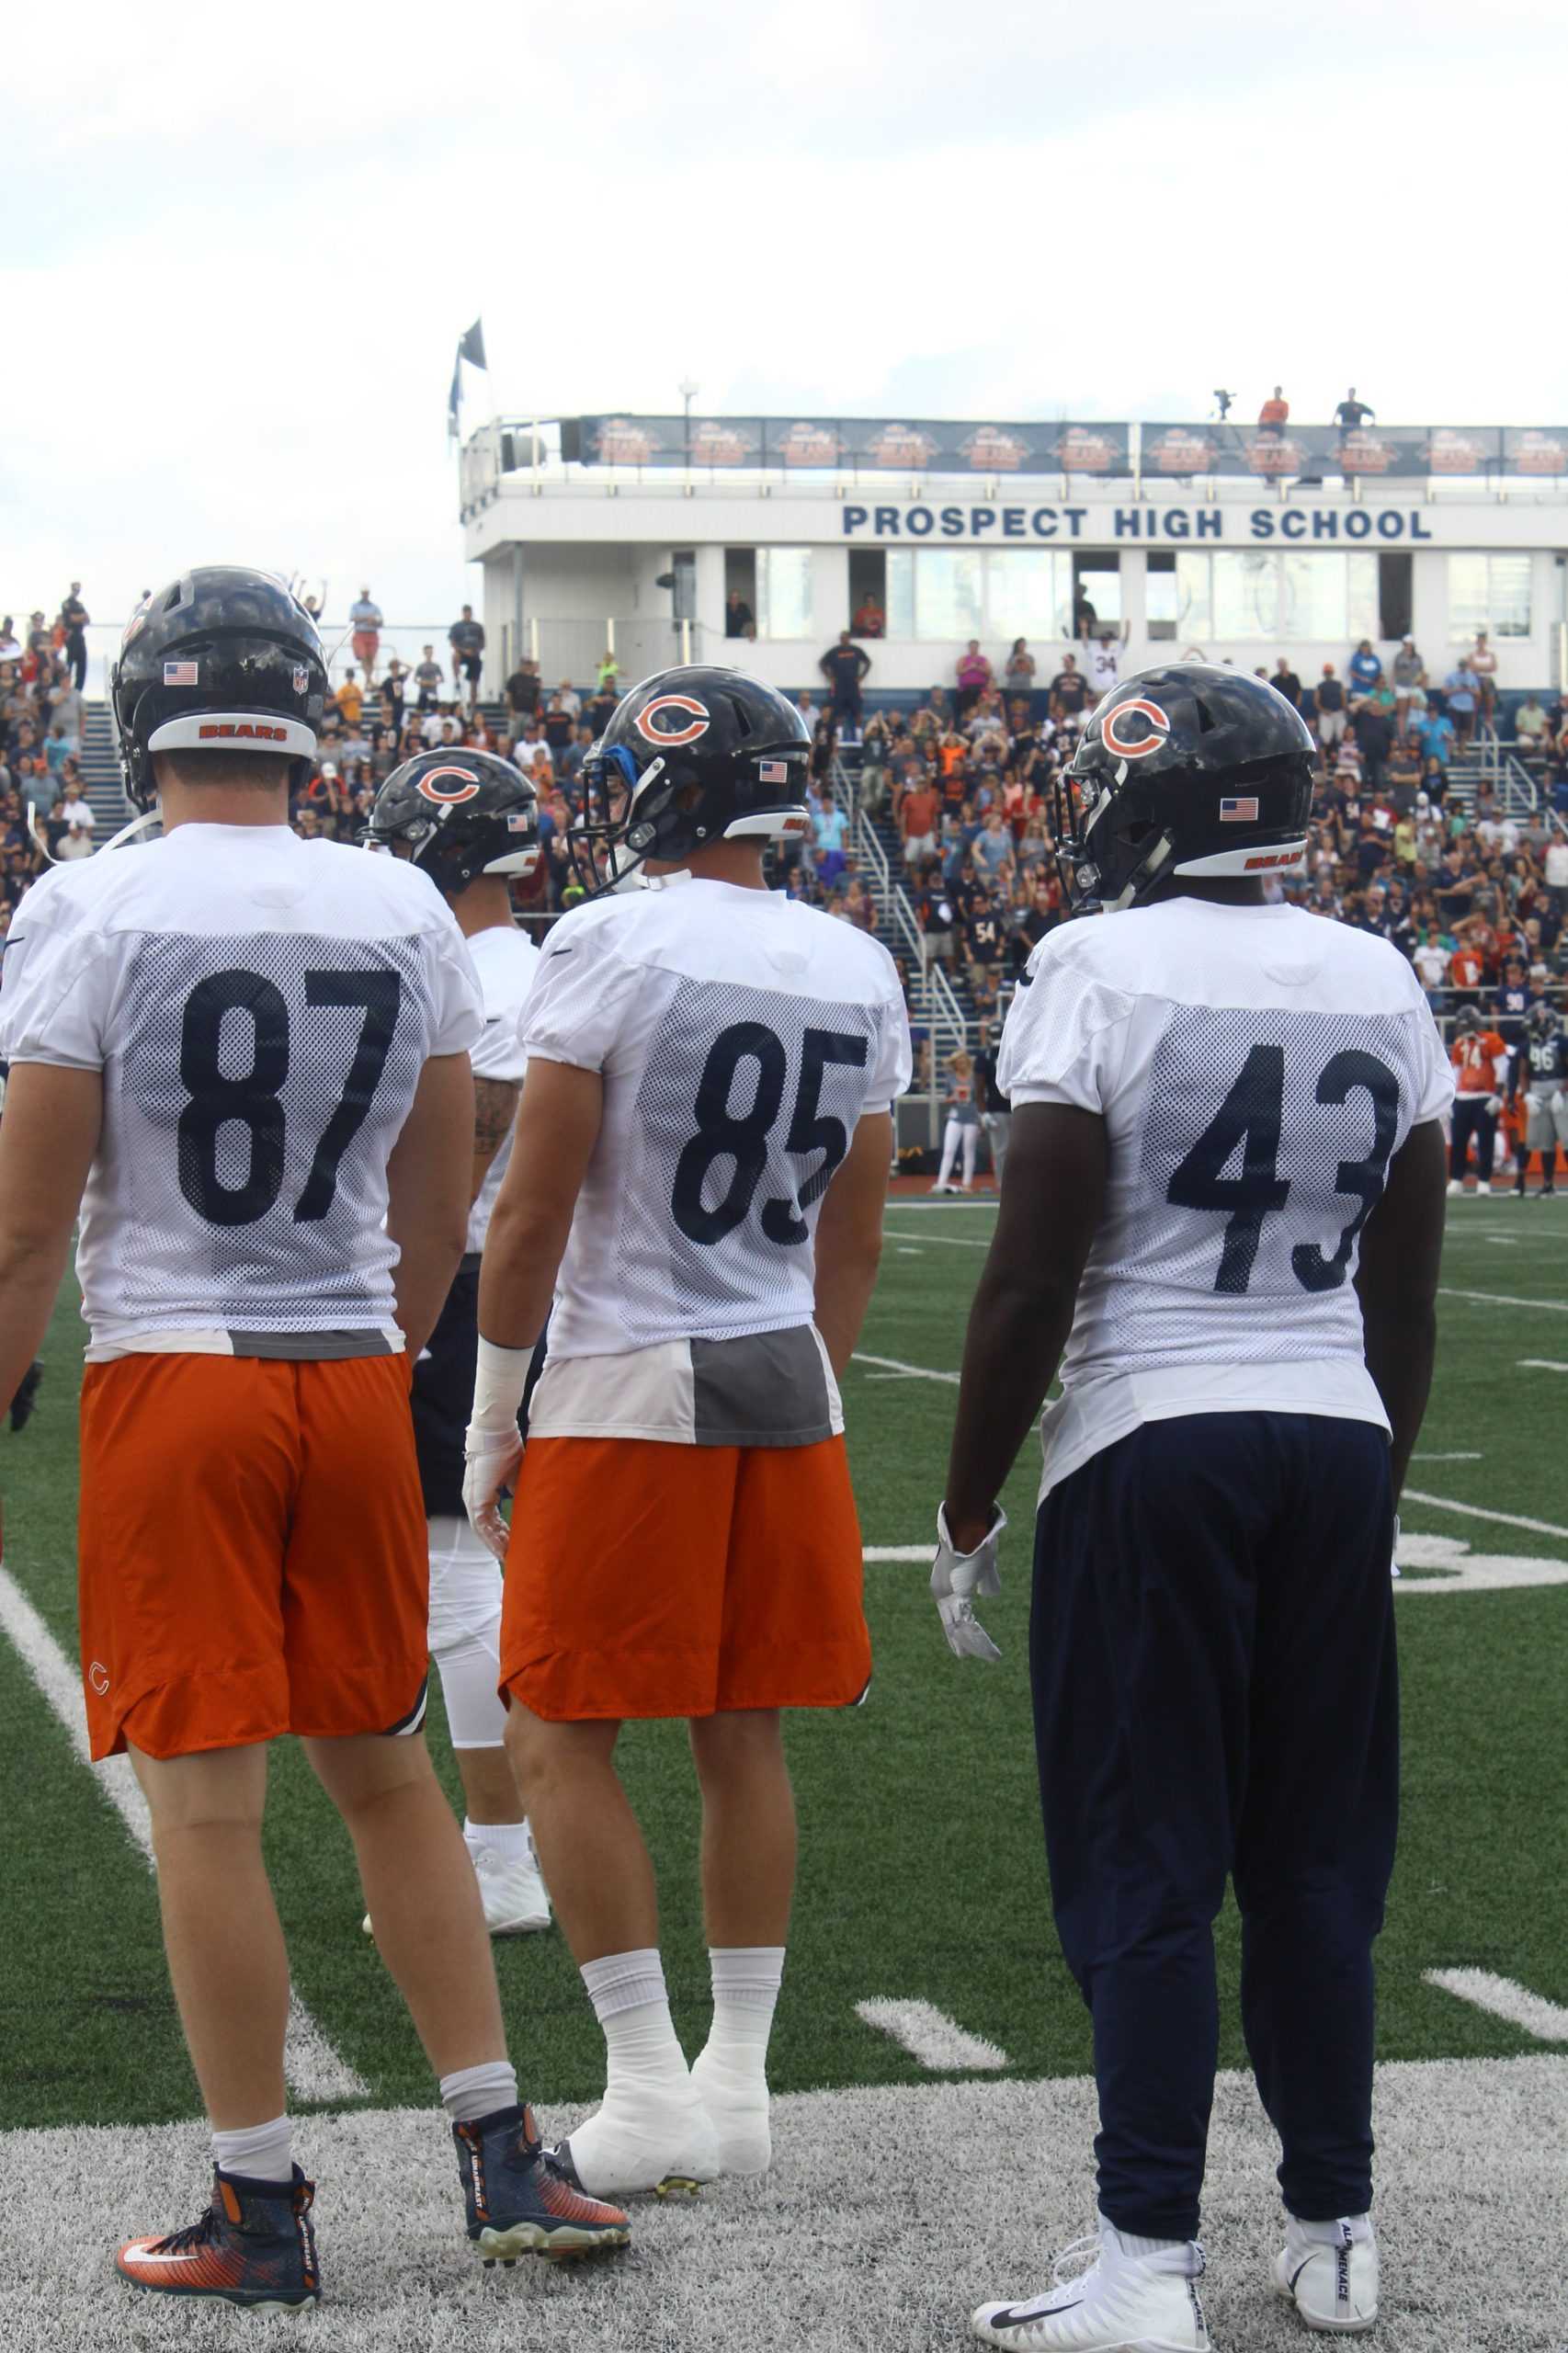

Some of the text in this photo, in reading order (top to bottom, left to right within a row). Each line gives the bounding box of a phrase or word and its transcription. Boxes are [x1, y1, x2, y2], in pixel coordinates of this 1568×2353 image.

[843, 506, 1431, 539] PROSPECT HIGH SCHOOL
[1096, 656, 1117, 674] 34
[199, 723, 288, 743] BEARS
[634, 694, 710, 746] C
[1100, 698, 1170, 759] C
[415, 765, 481, 804] C
[975, 922, 995, 943] 54
[1529, 1044, 1554, 1072] 96
[177, 969, 402, 1226] 87
[671, 1021, 869, 1245] 85
[1166, 1044, 1400, 1293] 43
[1337, 2247, 1348, 2302] MENACE
